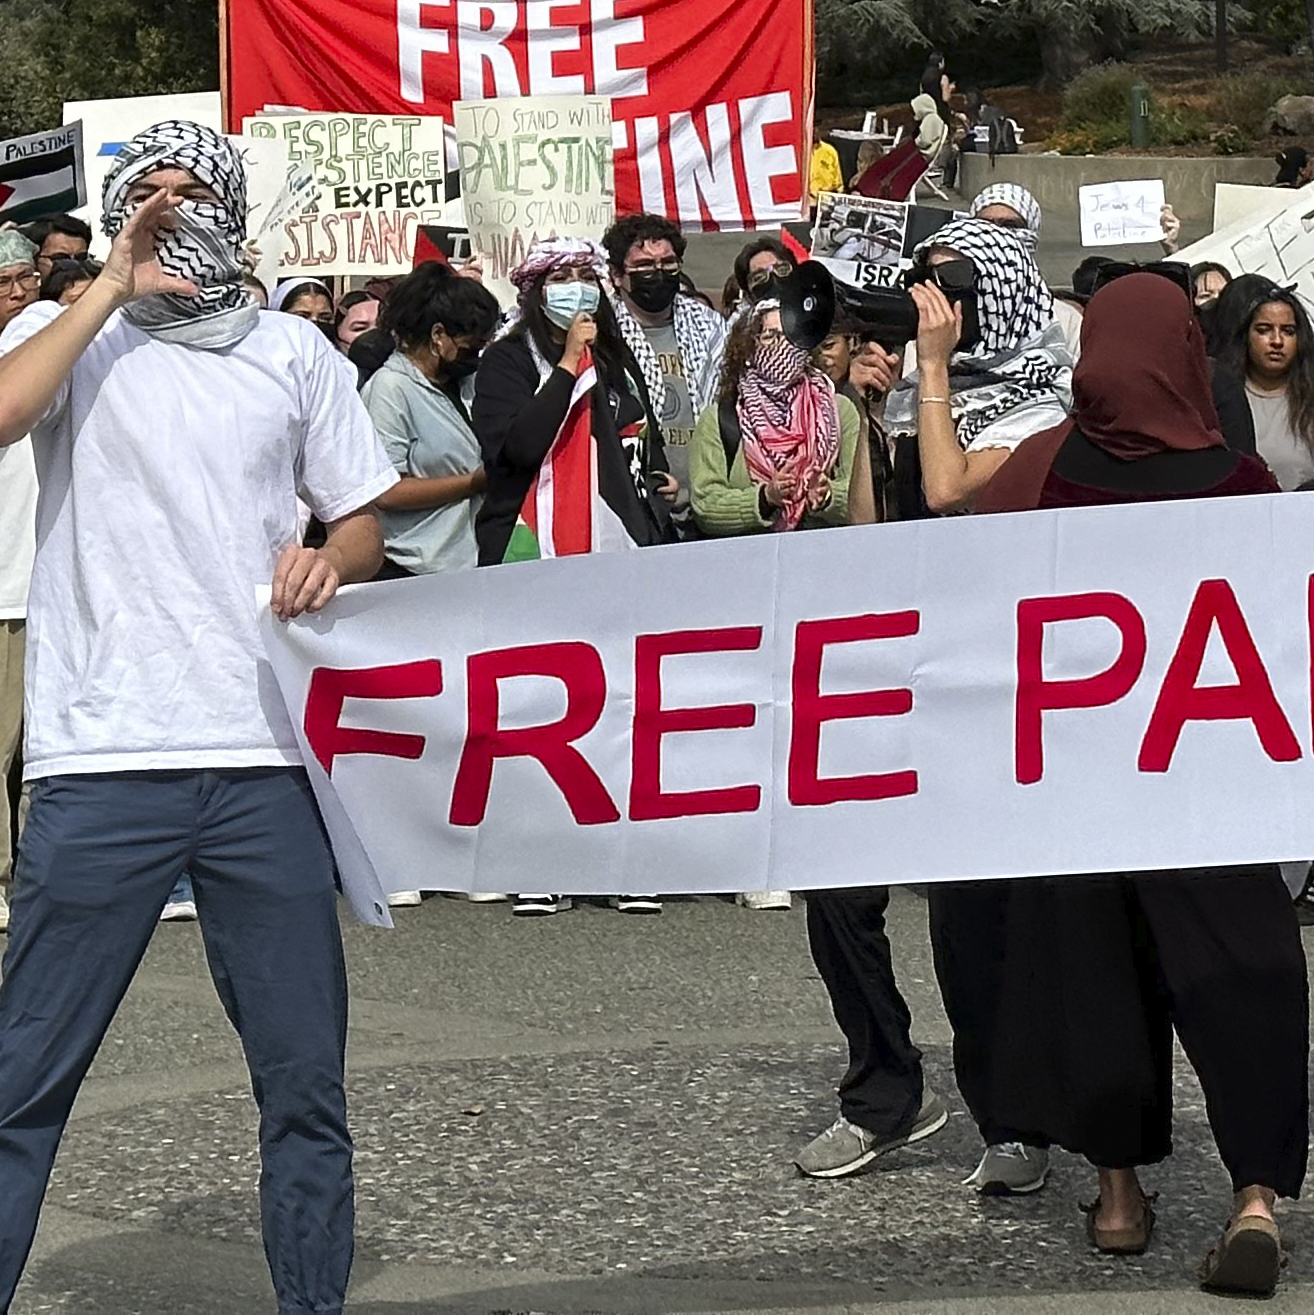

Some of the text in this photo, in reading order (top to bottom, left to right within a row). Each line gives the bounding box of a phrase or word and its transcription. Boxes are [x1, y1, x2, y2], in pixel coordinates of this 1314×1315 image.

[459, 102, 612, 138] TO STAND WITH
[5, 128, 76, 161] PALESTINE
[457, 134, 614, 197] PALESTINE
[334, 178, 443, 209] EXPECT
[469, 201, 484, 227] IS
[490, 197, 516, 225] TO
[525, 199, 582, 228] STAND
[305, 611, 921, 827] FREE
